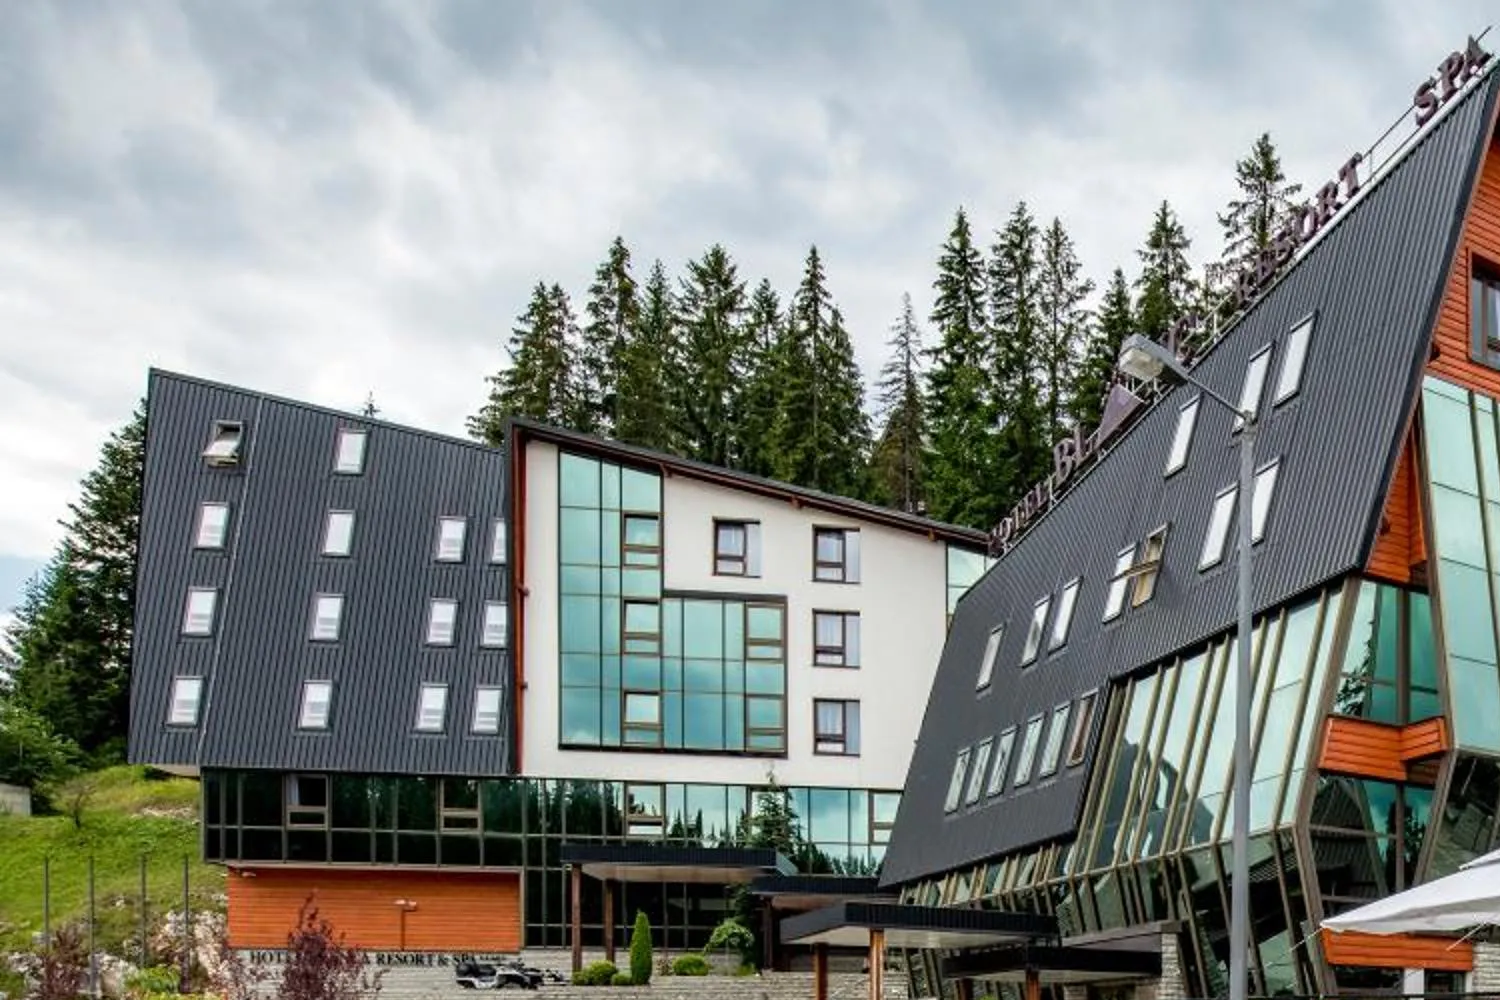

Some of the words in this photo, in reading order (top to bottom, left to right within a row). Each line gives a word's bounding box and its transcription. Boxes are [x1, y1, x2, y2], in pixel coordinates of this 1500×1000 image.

[1236, 152, 1363, 308] RESORT
[1413, 34, 1493, 128] SPA
[376, 953, 433, 967] RESORT
